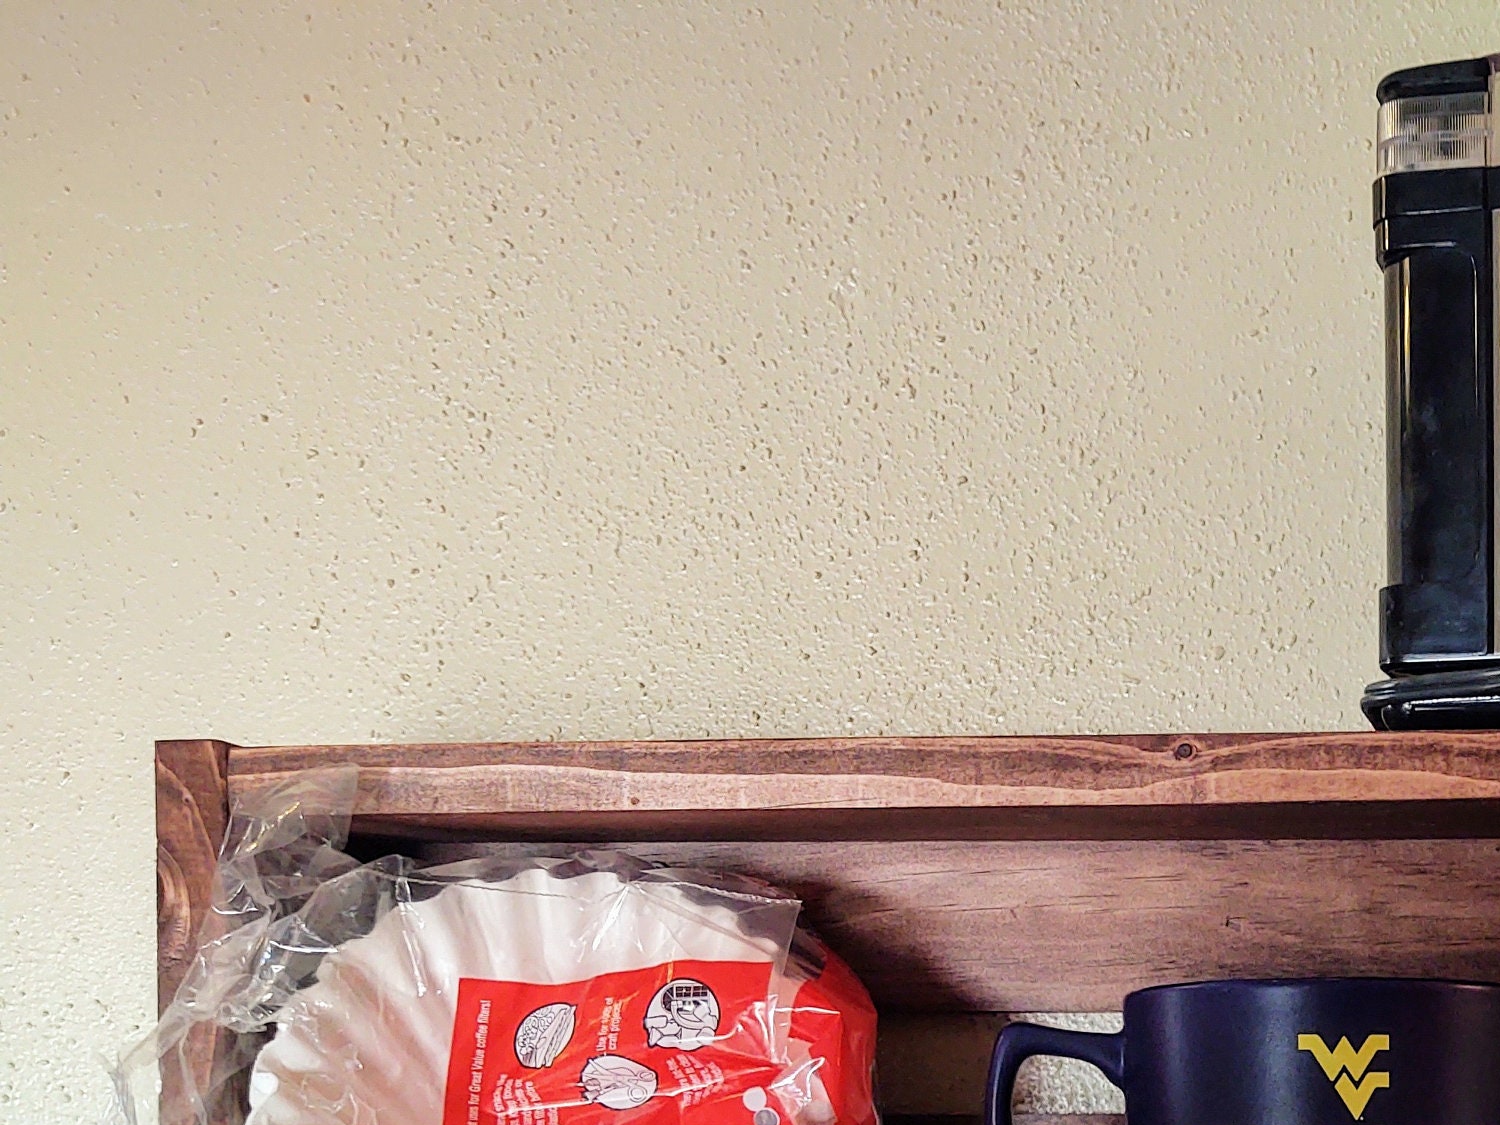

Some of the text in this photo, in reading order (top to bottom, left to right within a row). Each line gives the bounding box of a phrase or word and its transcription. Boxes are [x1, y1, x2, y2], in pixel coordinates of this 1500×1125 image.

[475, 1025, 488, 1048] coffee
[471, 1050, 484, 1070] Value
[469, 1071, 482, 1092] Great
